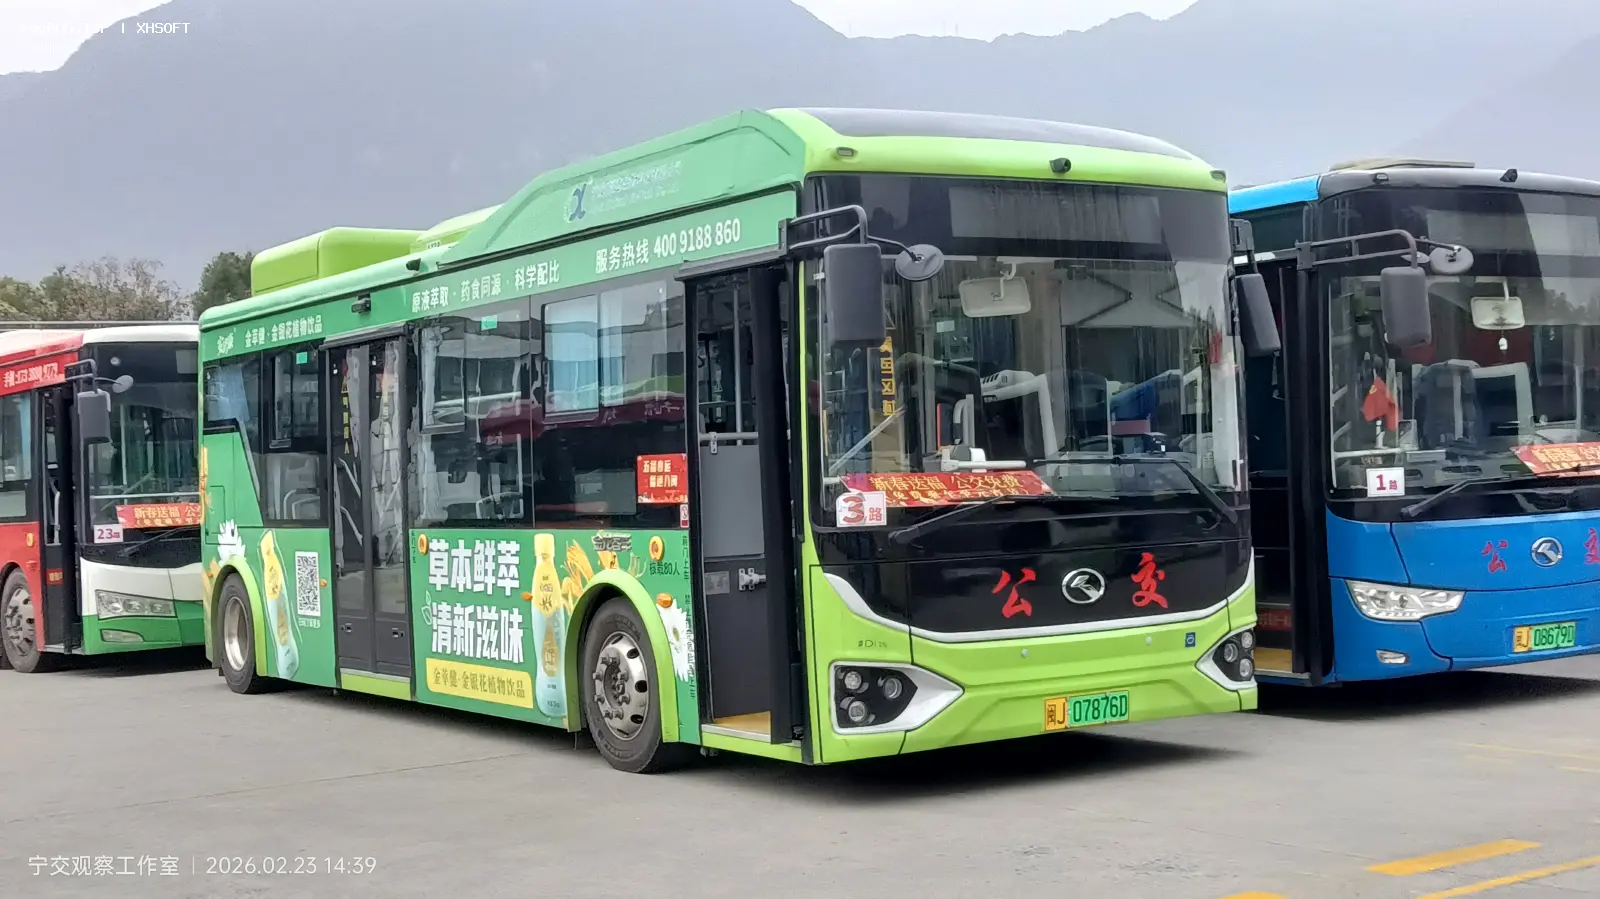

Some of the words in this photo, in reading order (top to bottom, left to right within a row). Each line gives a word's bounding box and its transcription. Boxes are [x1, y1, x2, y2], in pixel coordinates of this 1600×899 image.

[595, 238, 650, 273] 服务热线
[653, 232, 677, 260] 400
[679, 225, 713, 254] 9188
[715, 217, 741, 246] 860
[411, 287, 449, 314] 原液萃取
[460, 273, 502, 303] 药食同源
[514, 259, 561, 290] 科学配比
[871, 475, 945, 491] 新春送福
[951, 473, 1022, 490] 公交免费
[428, 539, 520, 596] 草本鲜萃
[992, 568, 1036, 618] 公
[1131, 552, 1168, 609] 交
[431, 601, 524, 664] 清新滋味
